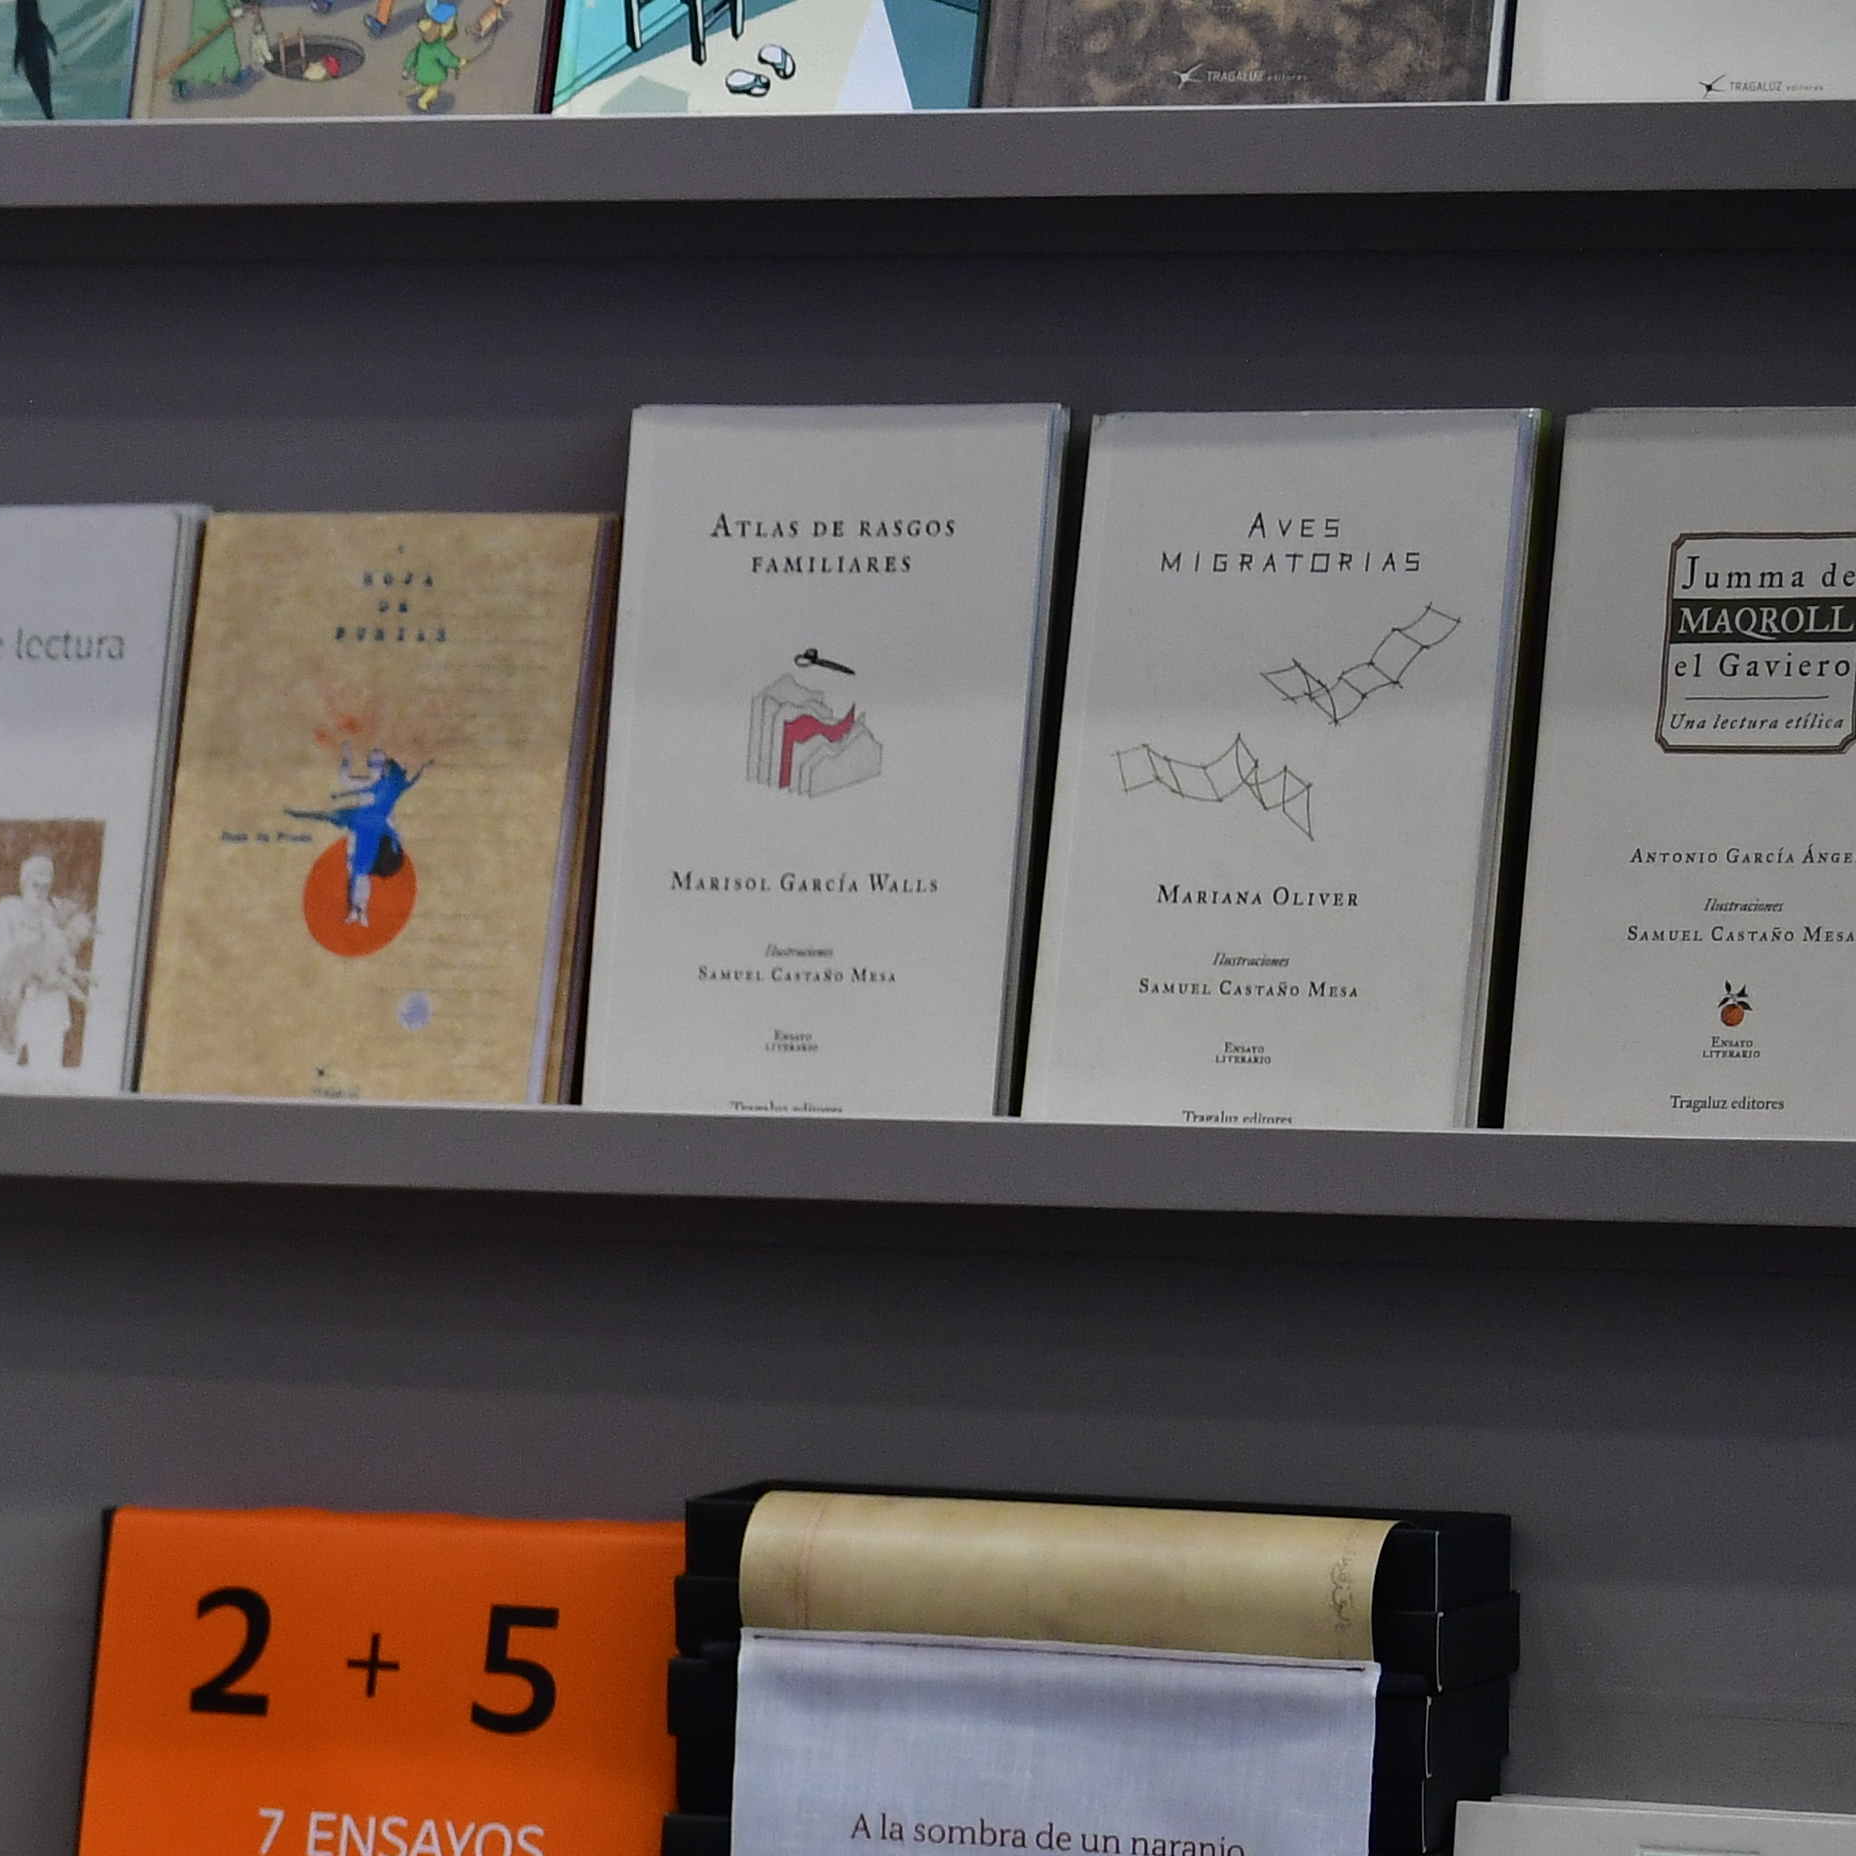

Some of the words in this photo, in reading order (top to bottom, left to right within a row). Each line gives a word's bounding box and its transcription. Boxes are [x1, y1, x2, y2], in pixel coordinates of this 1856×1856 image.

[710, 512, 800, 539] ATLAS
[811, 519, 845, 538] DE
[858, 518, 957, 540] RASGOS
[1248, 511, 1341, 539] AVES
[750, 555, 912, 574] FAMILIARES
[1159, 551, 1422, 574] MIGRATORIAS
[1680, 554, 1806, 591] Jumma
[1820, 561, 1856, 590] de
[1677, 604, 1855, 641] MAQROLL
[16, 627, 125, 661] lectura
[1673, 652, 1702, 678] el
[1718, 651, 1852, 679] Gaviero
[1668, 712, 1708, 730] Una
[1712, 712, 1779, 731] lectura
[1784, 710, 1845, 731] etílica
[1156, 883, 1263, 906] MARIANA
[1271, 885, 1360, 908] OLIVER
[1670, 1094, 1729, 1114] Tragaluz
[1730, 1094, 1786, 1111] editores
[188, 1585, 273, 1718] 2
[470, 1603, 561, 1736] 5
[257, 1808, 286, 1856] 7
[850, 1813, 873, 1841] A
[879, 1813, 906, 1843] la
[913, 1816, 1029, 1850] sombra
[1034, 1821, 1073, 1853] de
[1080, 1832, 1122, 1856] un
